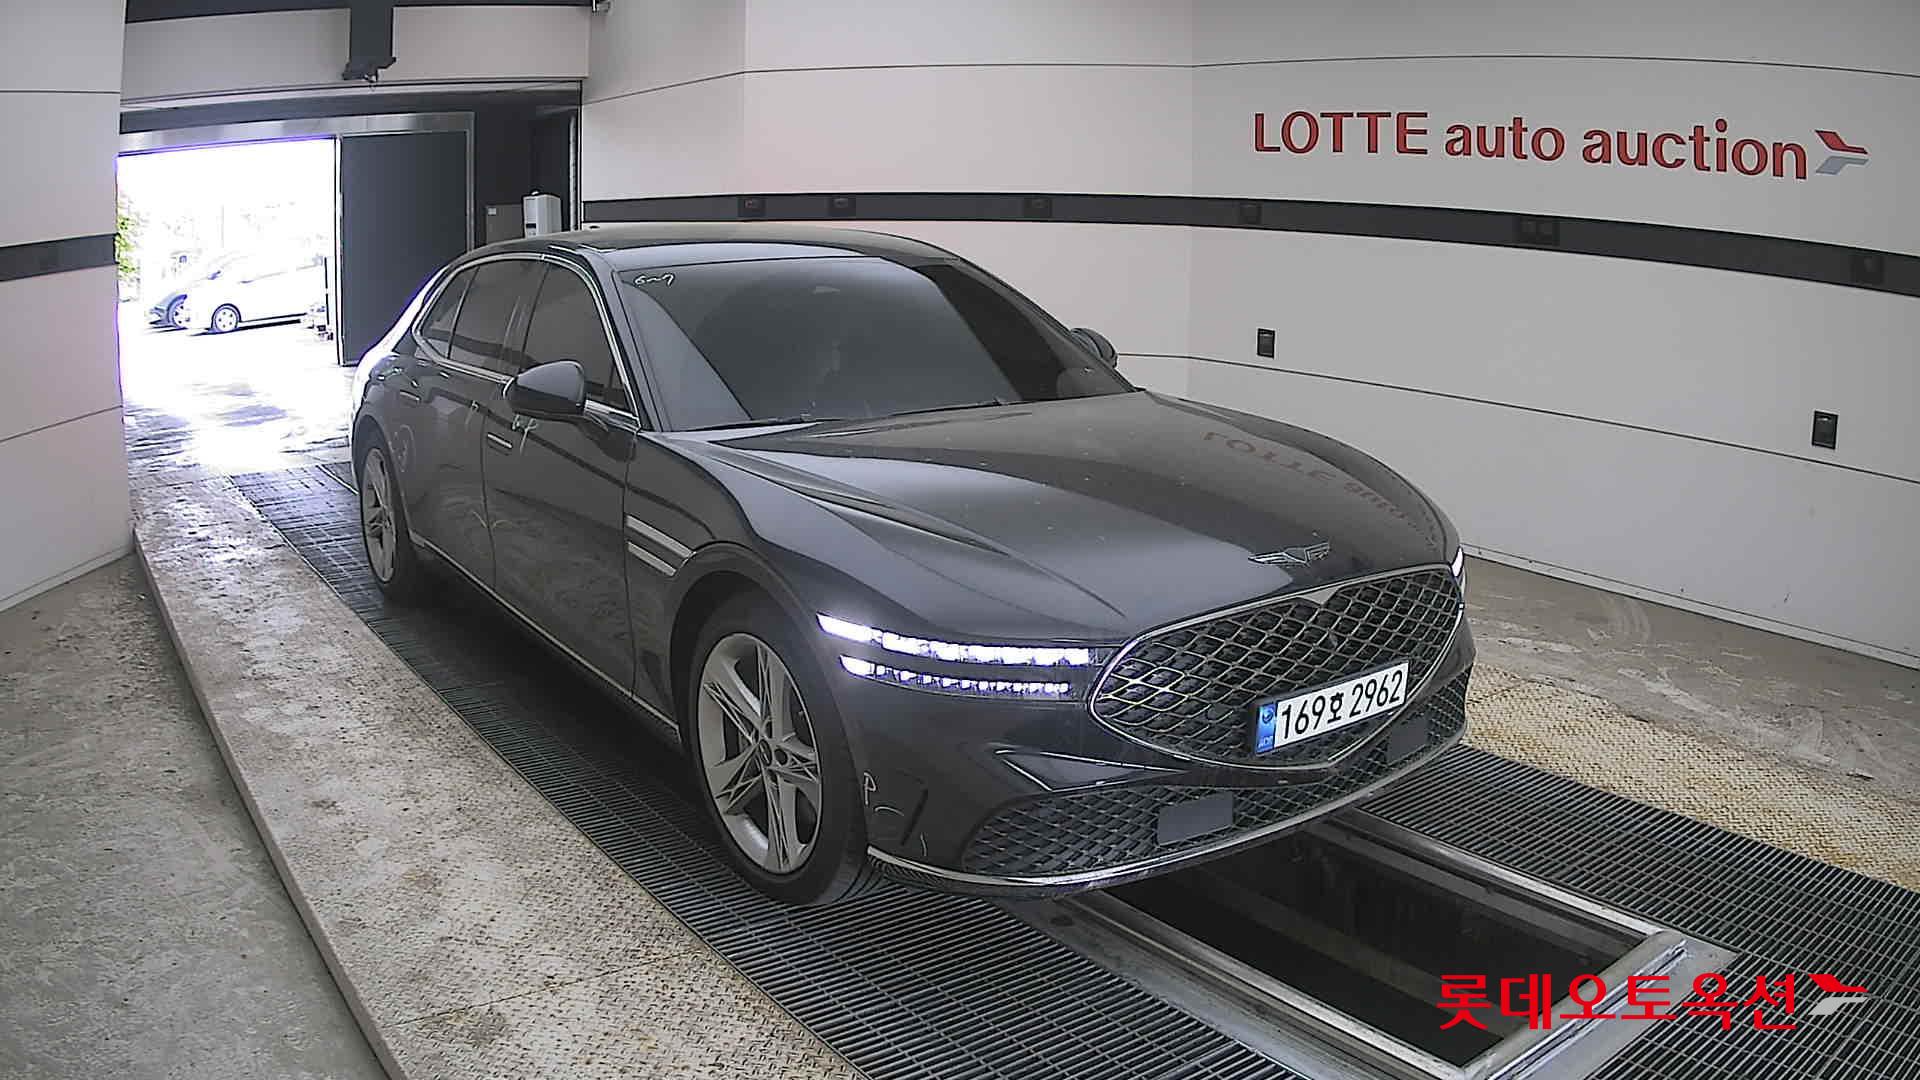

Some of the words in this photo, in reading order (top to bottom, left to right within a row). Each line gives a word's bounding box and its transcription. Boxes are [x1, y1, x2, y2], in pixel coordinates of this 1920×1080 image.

[1254, 111, 1429, 155] LOTTE
[1445, 116, 1566, 163] auto
[1582, 119, 1808, 180] auction
[1349, 670, 1403, 718] 2962
